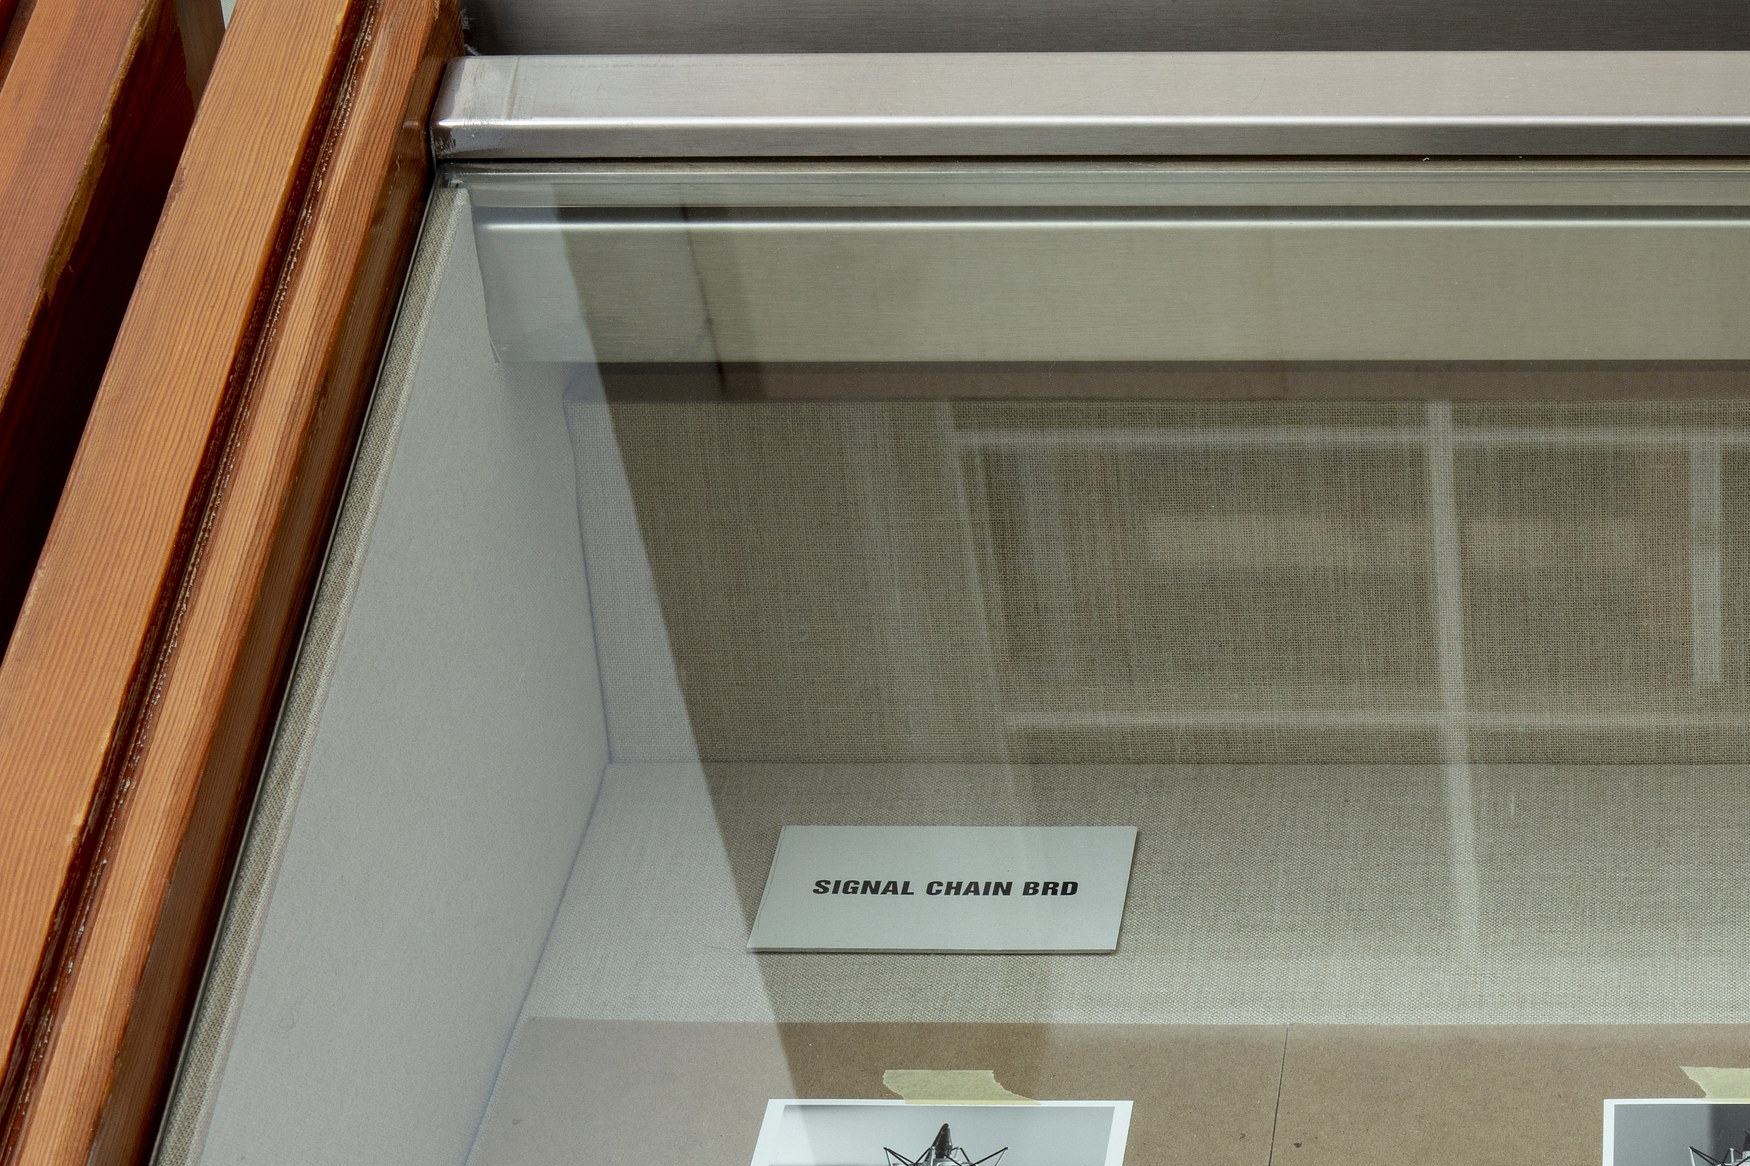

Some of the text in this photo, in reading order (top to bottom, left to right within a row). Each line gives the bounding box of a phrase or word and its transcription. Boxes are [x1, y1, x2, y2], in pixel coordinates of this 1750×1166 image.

[812, 879, 1079, 896] SIGNAL CHAIN BRD
